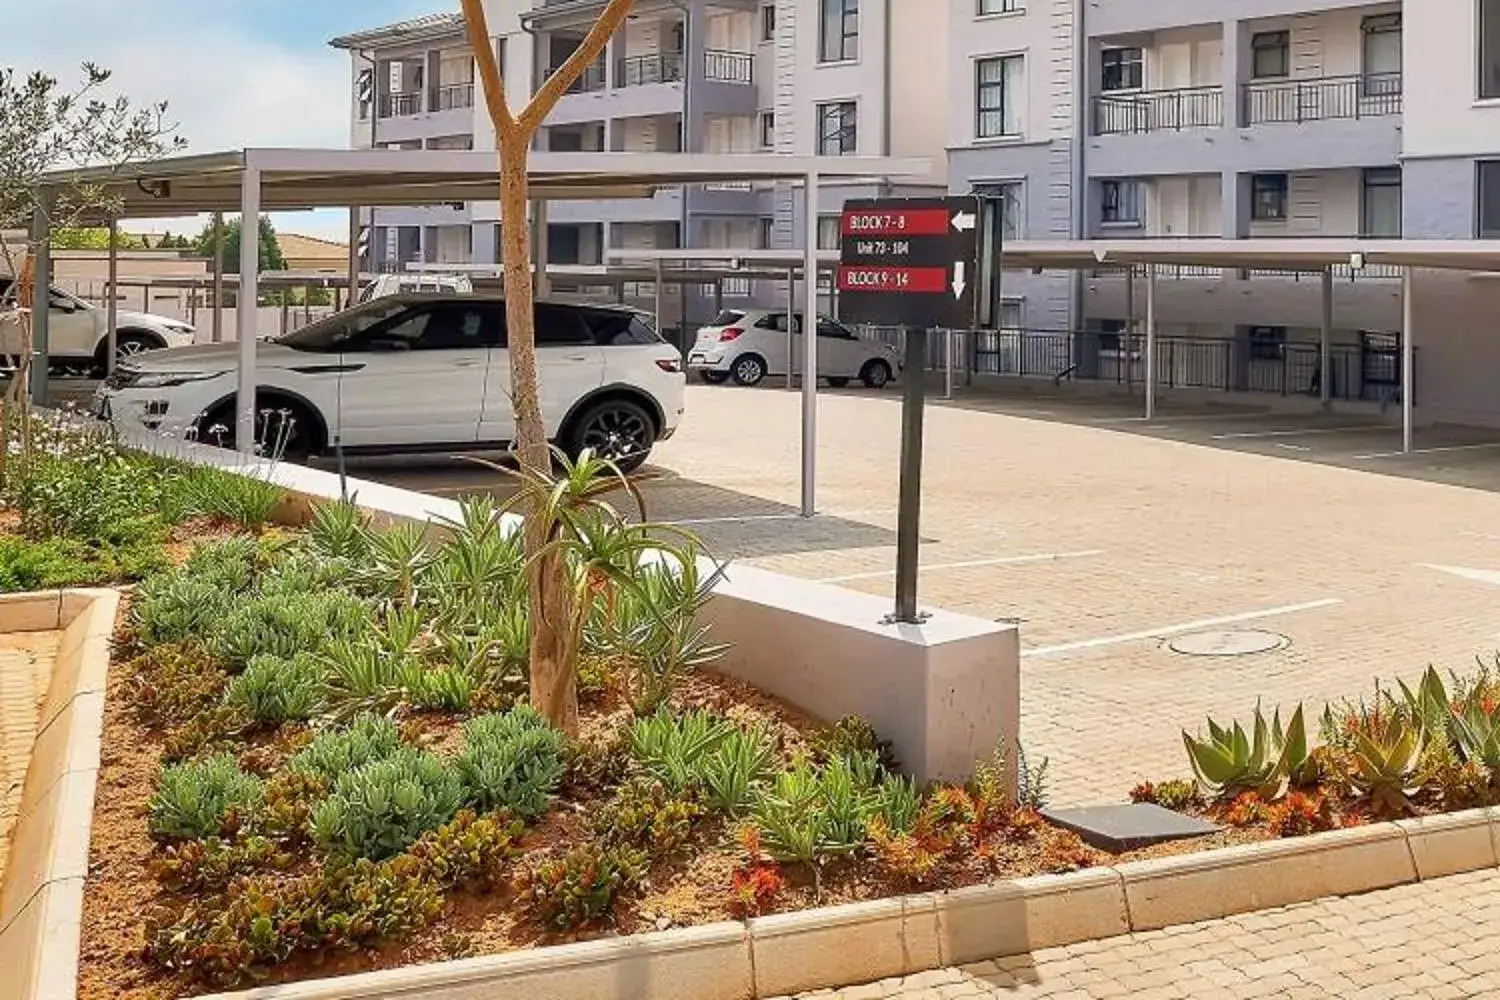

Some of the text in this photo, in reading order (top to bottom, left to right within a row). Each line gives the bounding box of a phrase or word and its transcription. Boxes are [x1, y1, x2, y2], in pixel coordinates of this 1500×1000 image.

[850, 215, 883, 229] BLOCK
[885, 215, 891, 229] 7
[847, 271, 880, 285] BLOCK
[896, 272, 909, 287] 14
